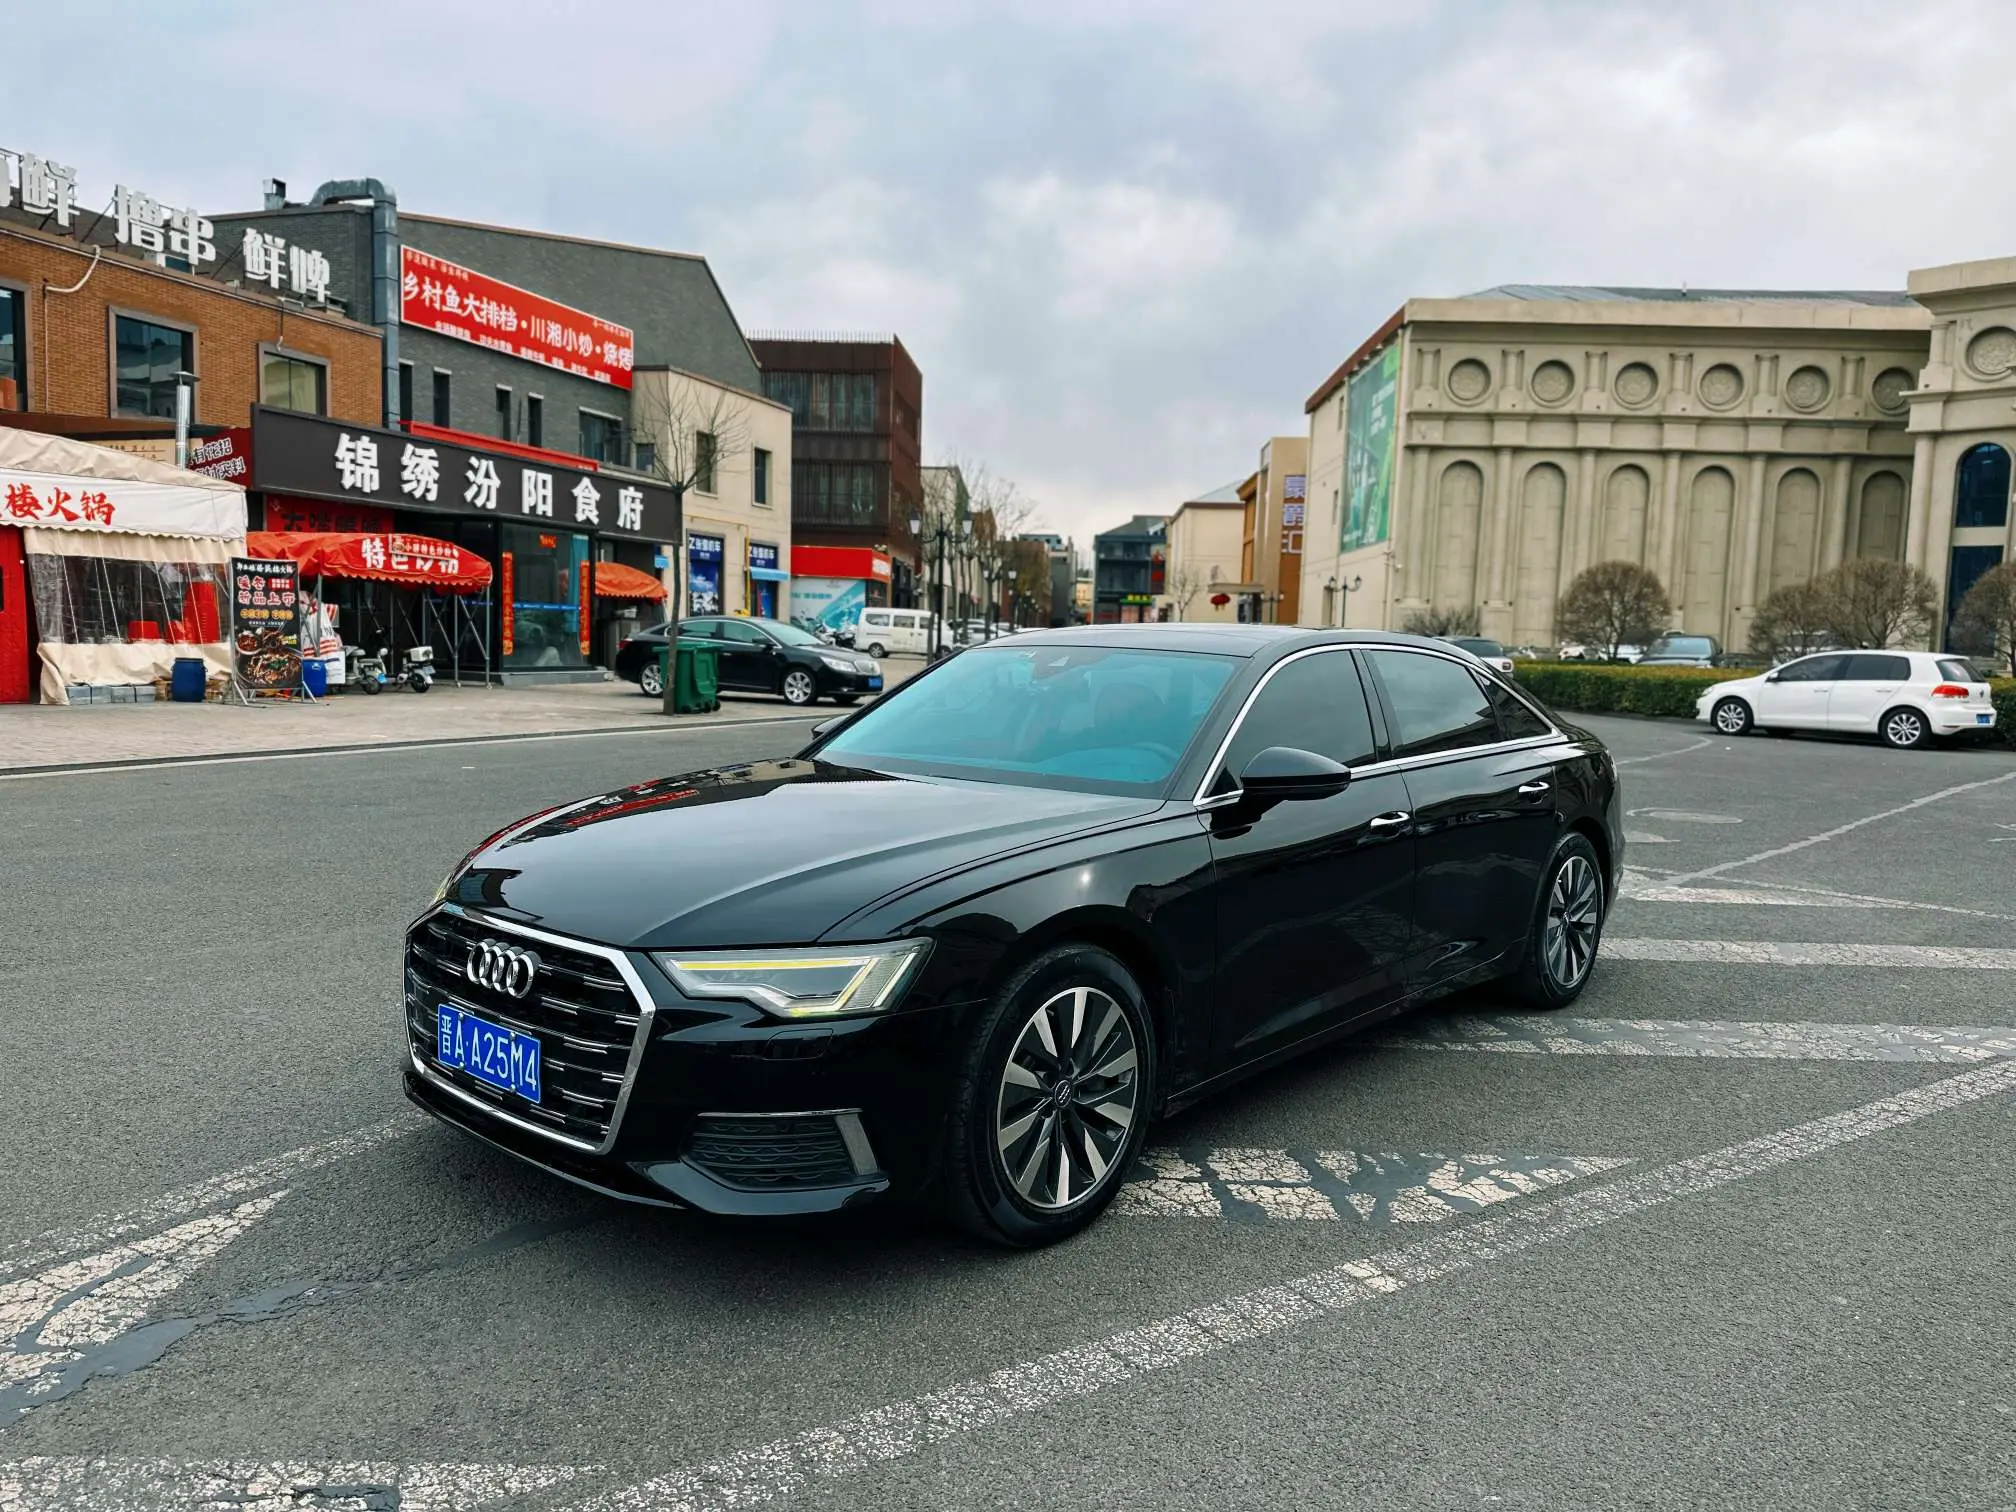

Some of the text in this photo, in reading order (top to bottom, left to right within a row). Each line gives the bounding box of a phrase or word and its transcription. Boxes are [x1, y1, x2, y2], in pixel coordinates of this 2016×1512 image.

[0, 151, 80, 227] 鲜
[190, 438, 232, 465] 有花招
[334, 432, 644, 531] 锦绣汾阳食府
[4, 482, 116, 526] 楼火锅
